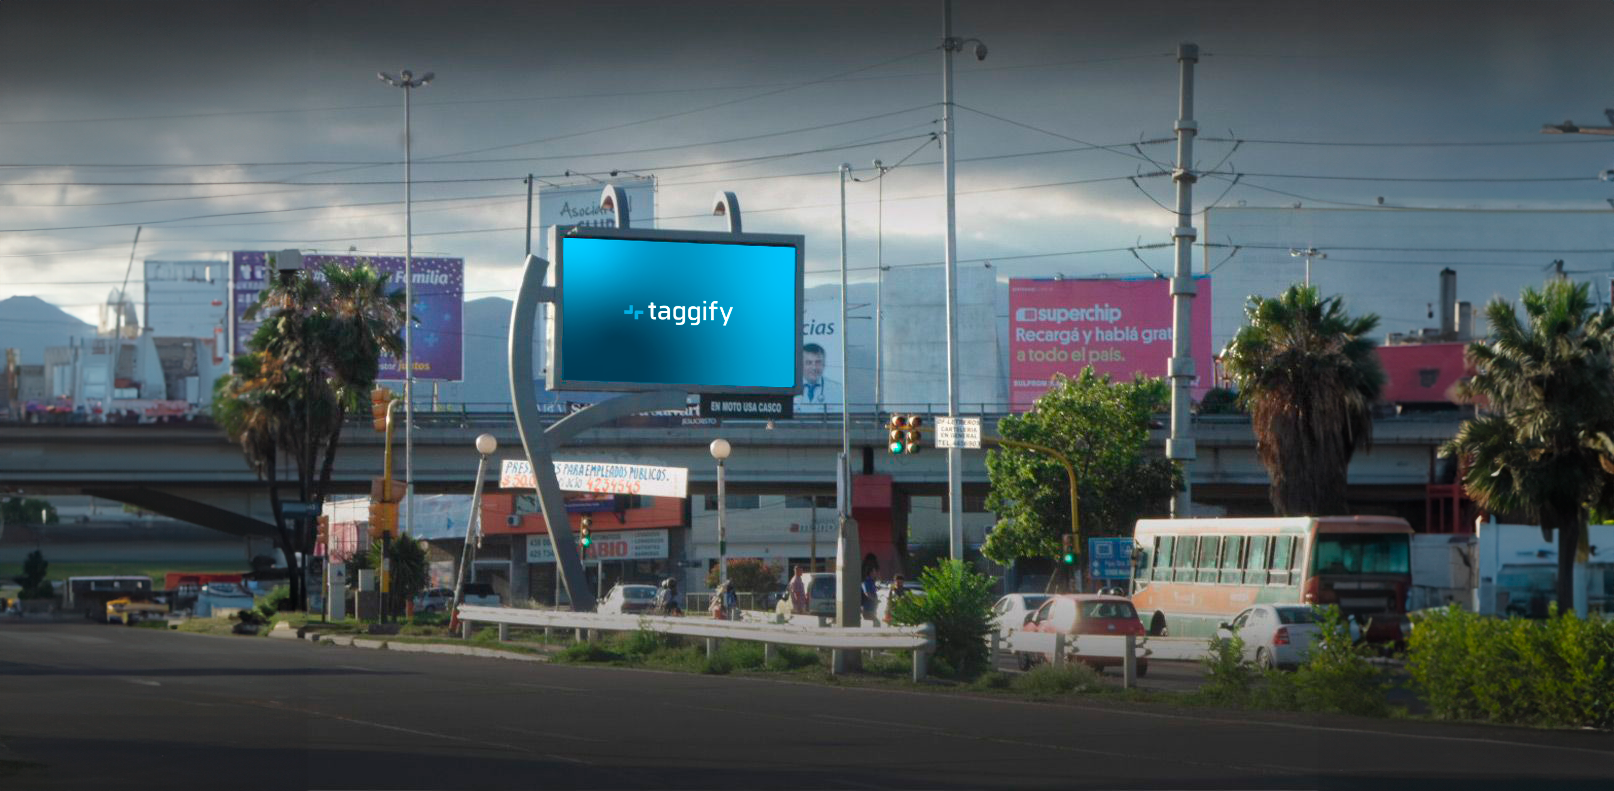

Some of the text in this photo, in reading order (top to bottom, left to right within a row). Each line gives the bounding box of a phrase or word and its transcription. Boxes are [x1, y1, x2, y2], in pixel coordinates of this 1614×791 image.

[648, 300, 733, 326] taggify
[1038, 303, 1122, 324] superchip
[1016, 327, 1173, 345] Recargá y hablá grat
[1017, 347, 1126, 365] a todo el país.
[711, 401, 721, 412] EN
[722, 401, 742, 412] MOTO
[743, 402, 757, 412] USA
[758, 402, 782, 413] CASCO
